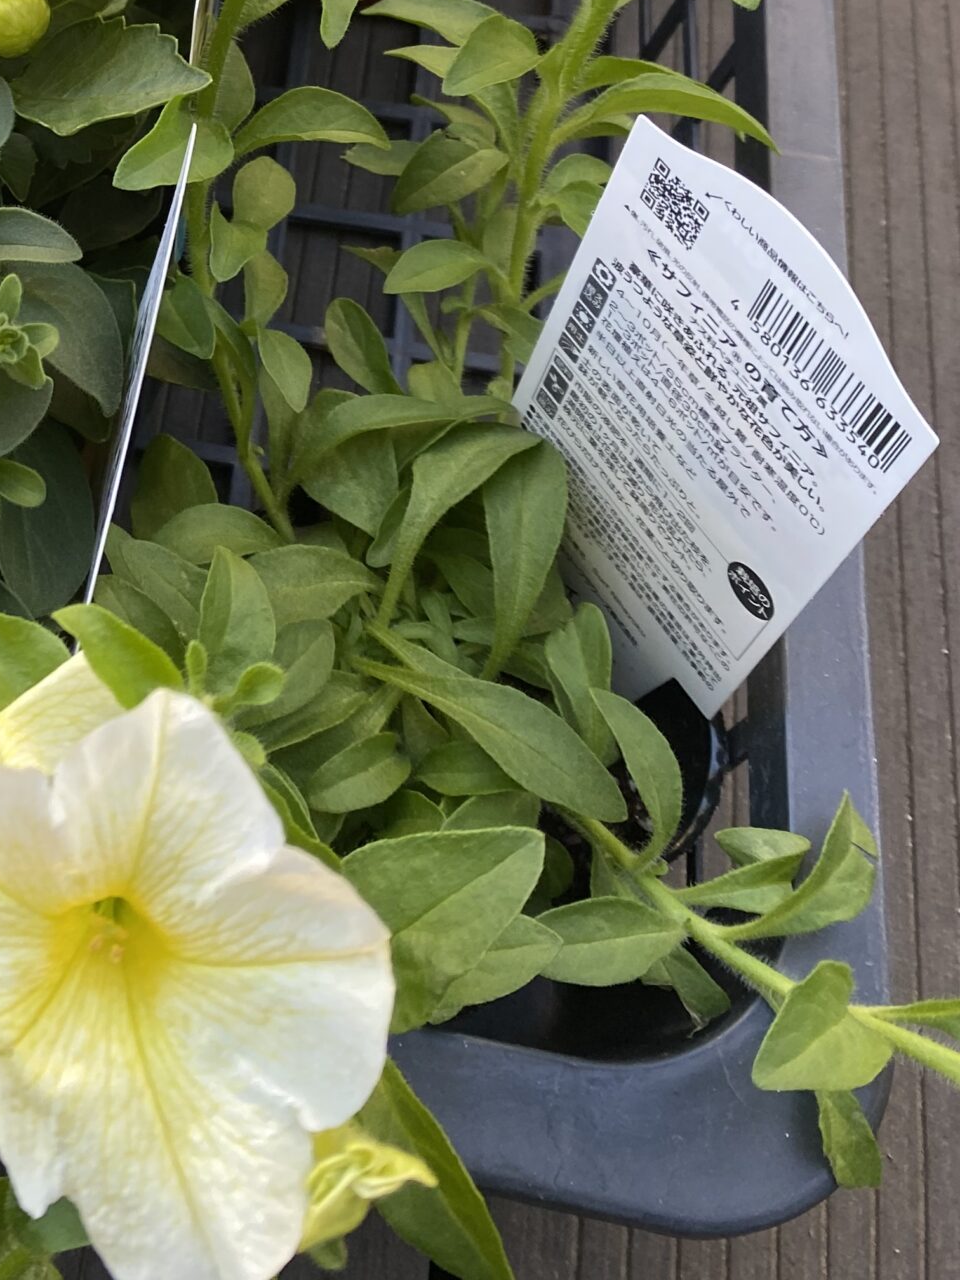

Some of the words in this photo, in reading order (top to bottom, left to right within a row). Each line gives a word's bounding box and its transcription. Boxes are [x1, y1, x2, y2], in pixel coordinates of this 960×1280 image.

[729, 296, 741, 312] 4
[749, 319, 813, 393] 580136
[814, 393, 882, 471] 633540
[726, 567, 770, 622] ポイント
